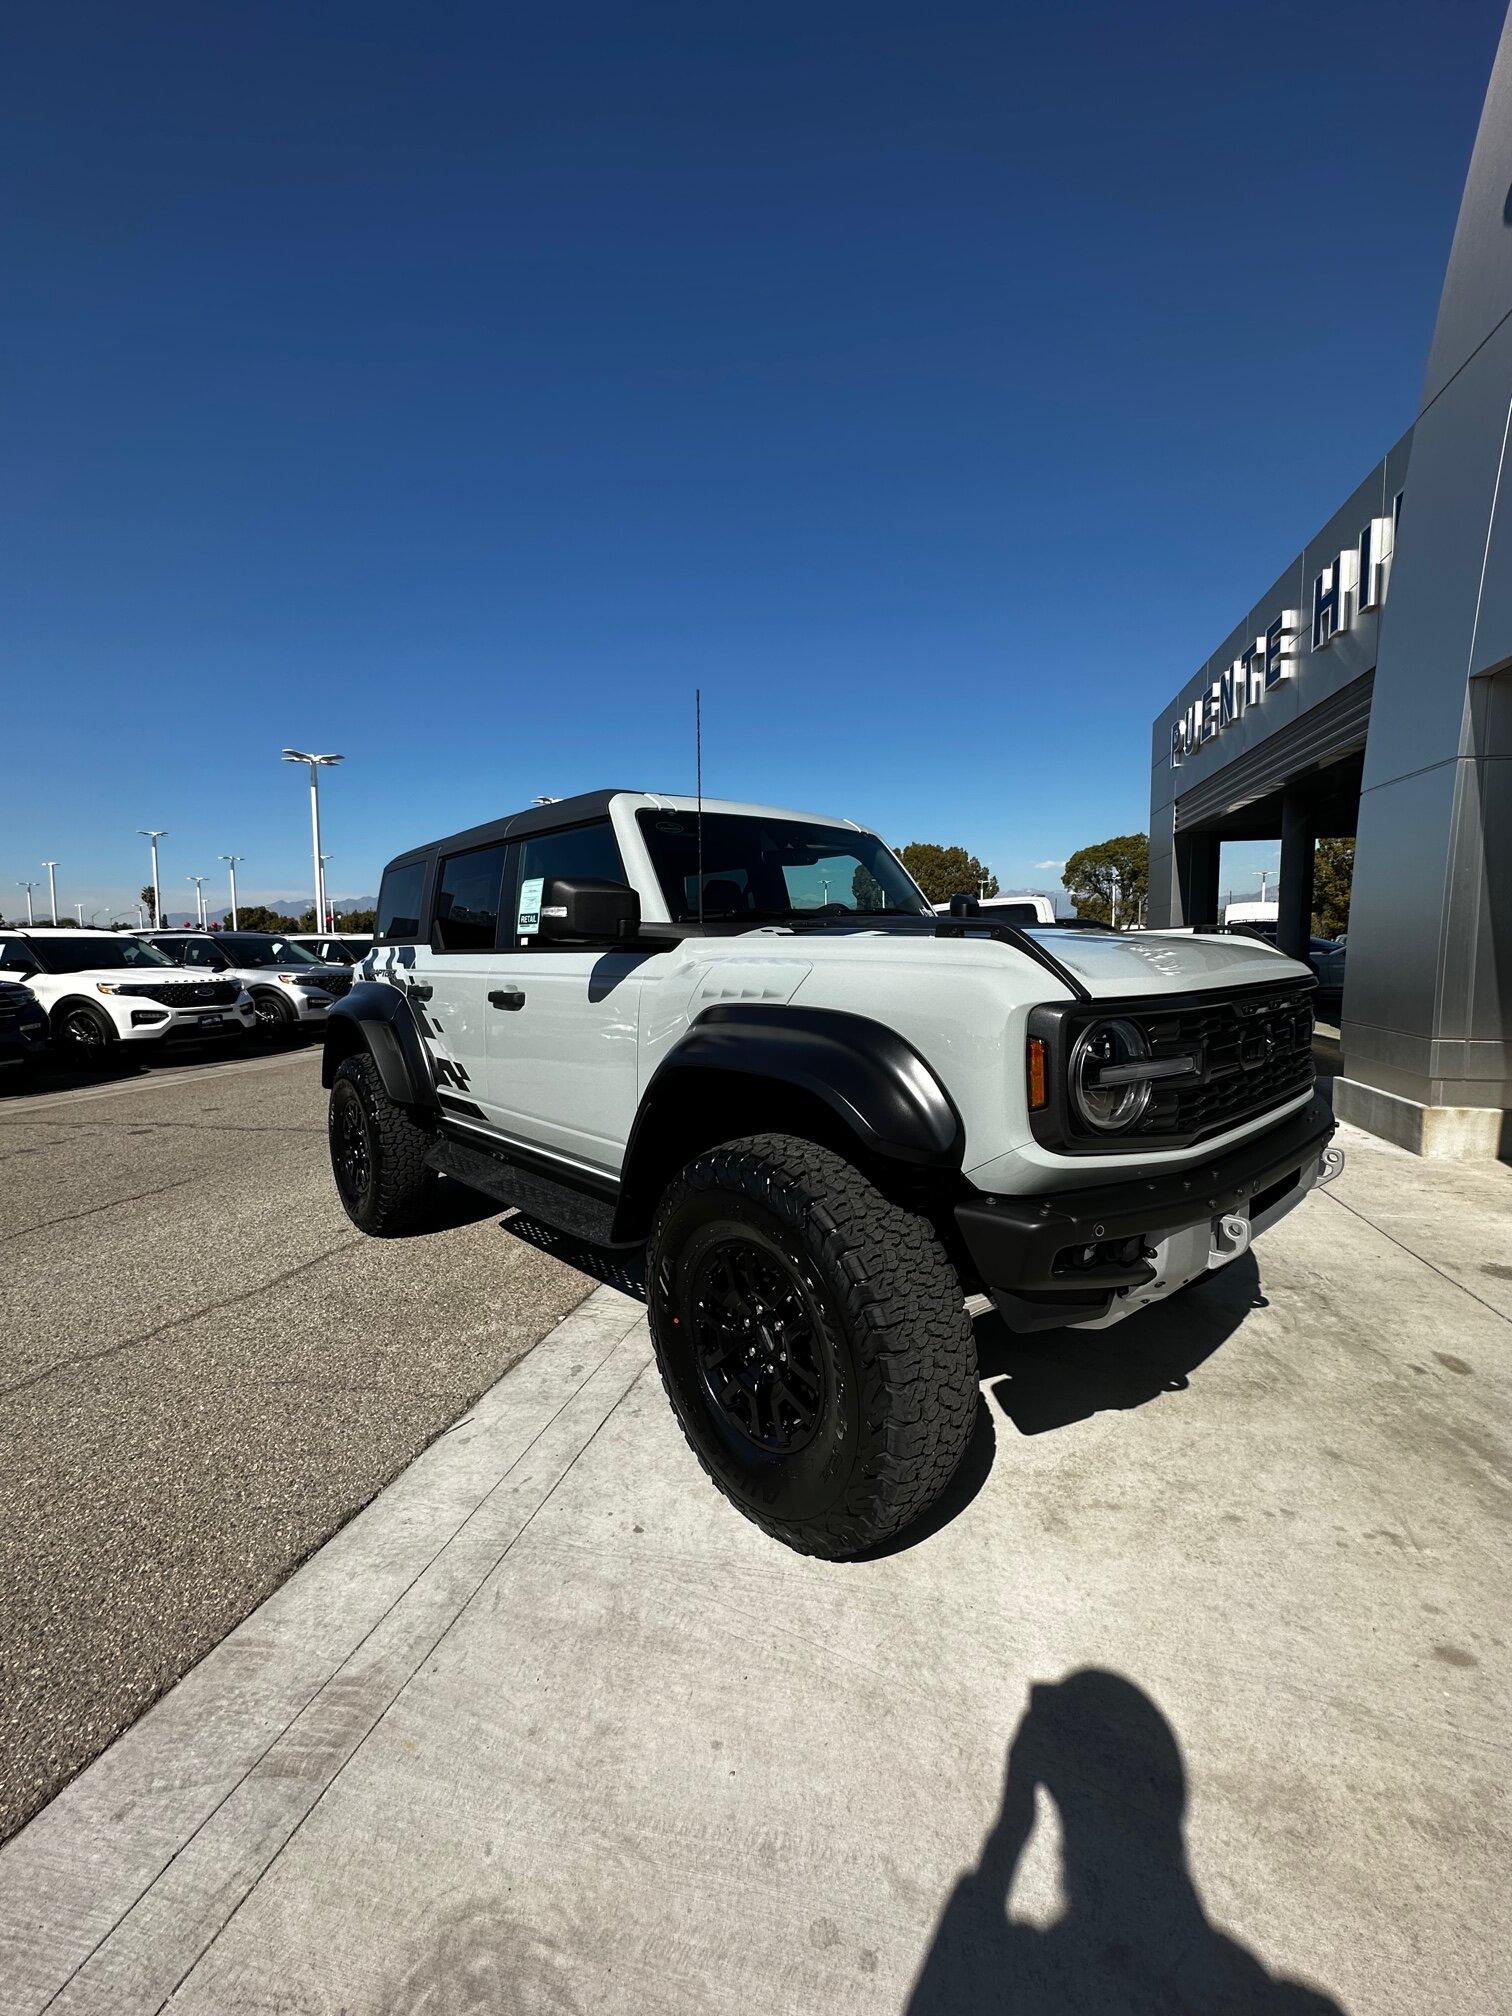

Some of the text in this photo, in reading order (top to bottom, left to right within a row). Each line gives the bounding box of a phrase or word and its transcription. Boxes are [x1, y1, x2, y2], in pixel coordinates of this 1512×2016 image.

[1170, 490, 1404, 769] PUENTE HI
[520, 915, 537, 923] RETAIL
